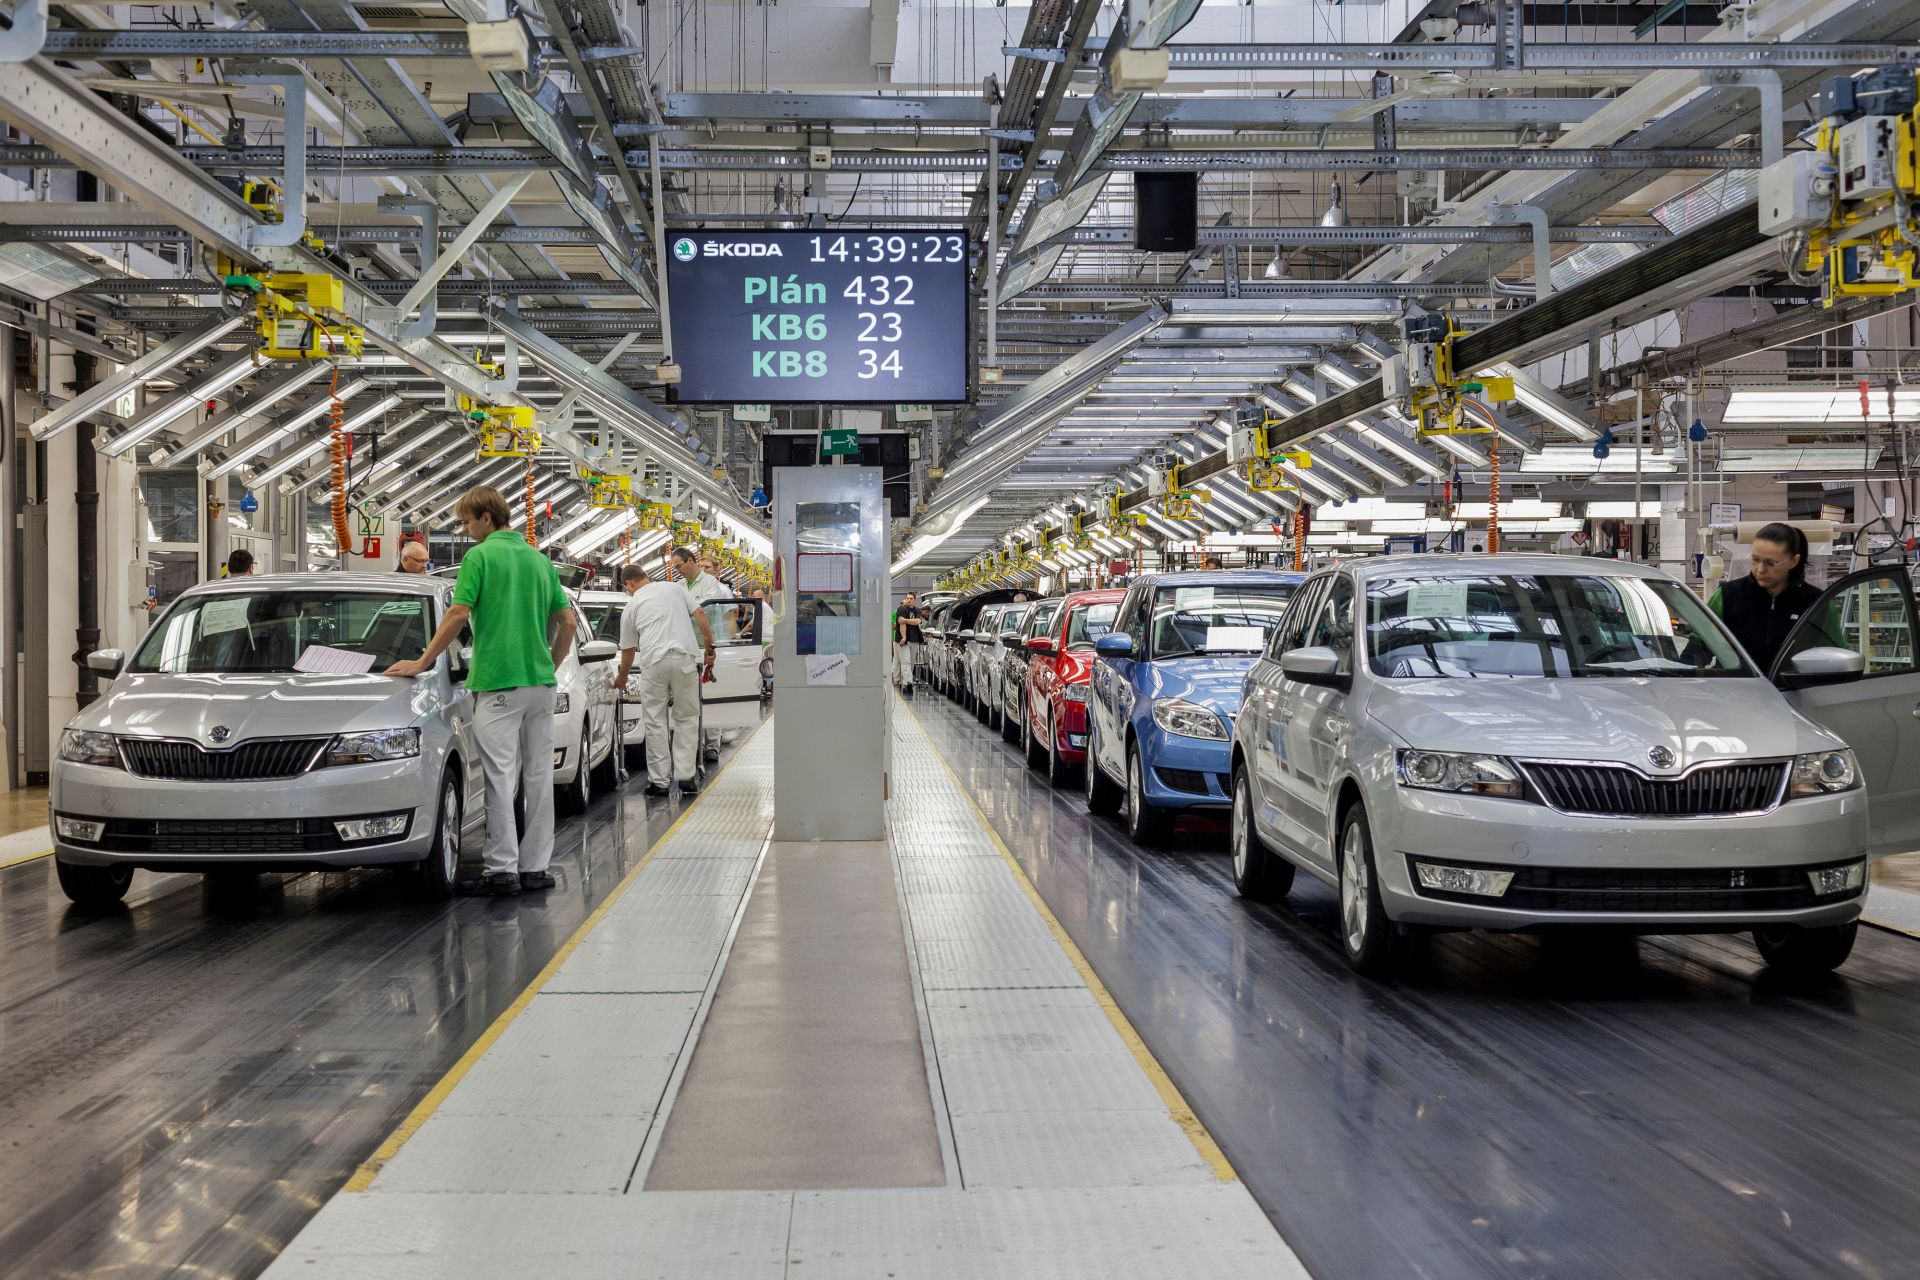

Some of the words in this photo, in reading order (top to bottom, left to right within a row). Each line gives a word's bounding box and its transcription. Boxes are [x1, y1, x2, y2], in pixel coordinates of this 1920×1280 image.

[703, 240, 783, 257] ŠKODA
[810, 236, 963, 263] 14:39:23
[744, 274, 827, 304] Plán
[843, 275, 915, 305] 432
[752, 314, 828, 341] KB6
[857, 312, 903, 342] 23
[752, 350, 828, 378] KB8
[857, 349, 904, 379] 34
[752, 404, 767, 413] 14
[914, 404, 928, 412] 14
[361, 516, 382, 533] 27
